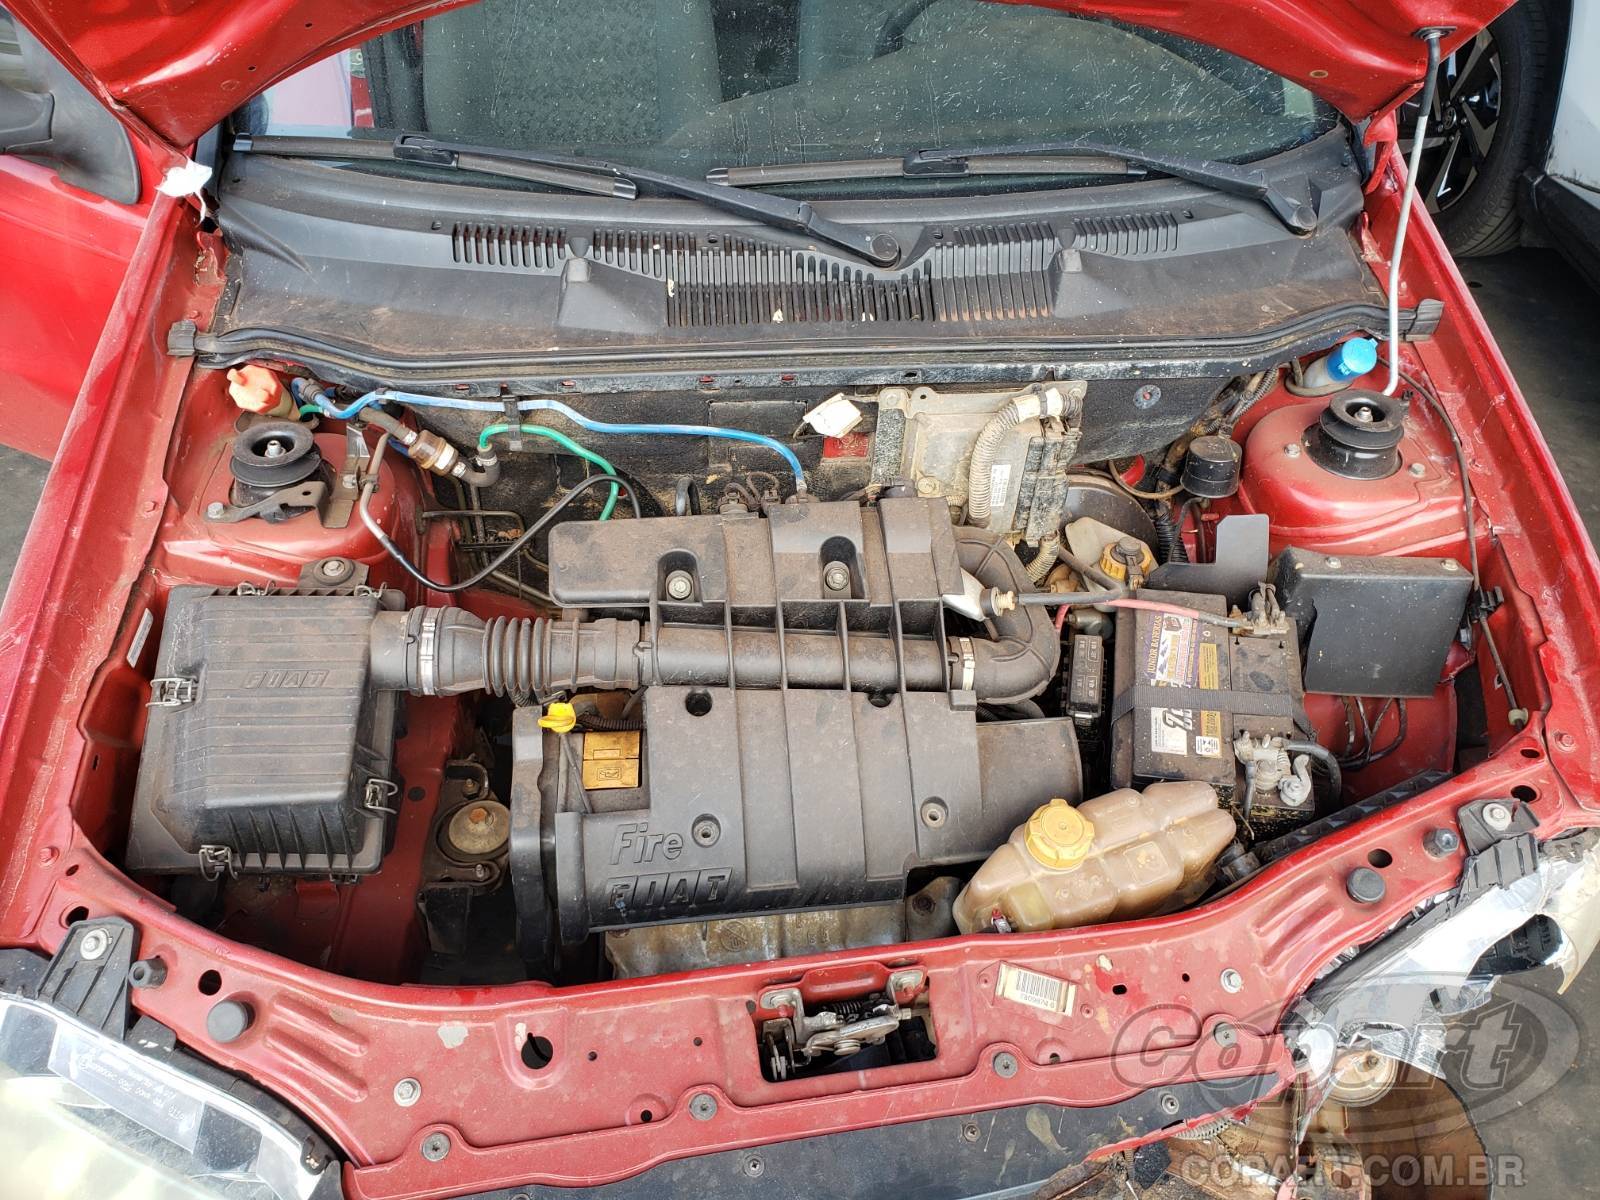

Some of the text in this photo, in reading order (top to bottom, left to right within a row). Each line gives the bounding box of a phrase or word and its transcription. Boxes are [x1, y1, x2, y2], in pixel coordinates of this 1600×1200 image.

[241, 669, 329, 689] FIAT
[610, 822, 684, 865] Fire
[605, 867, 732, 910] FIAT
